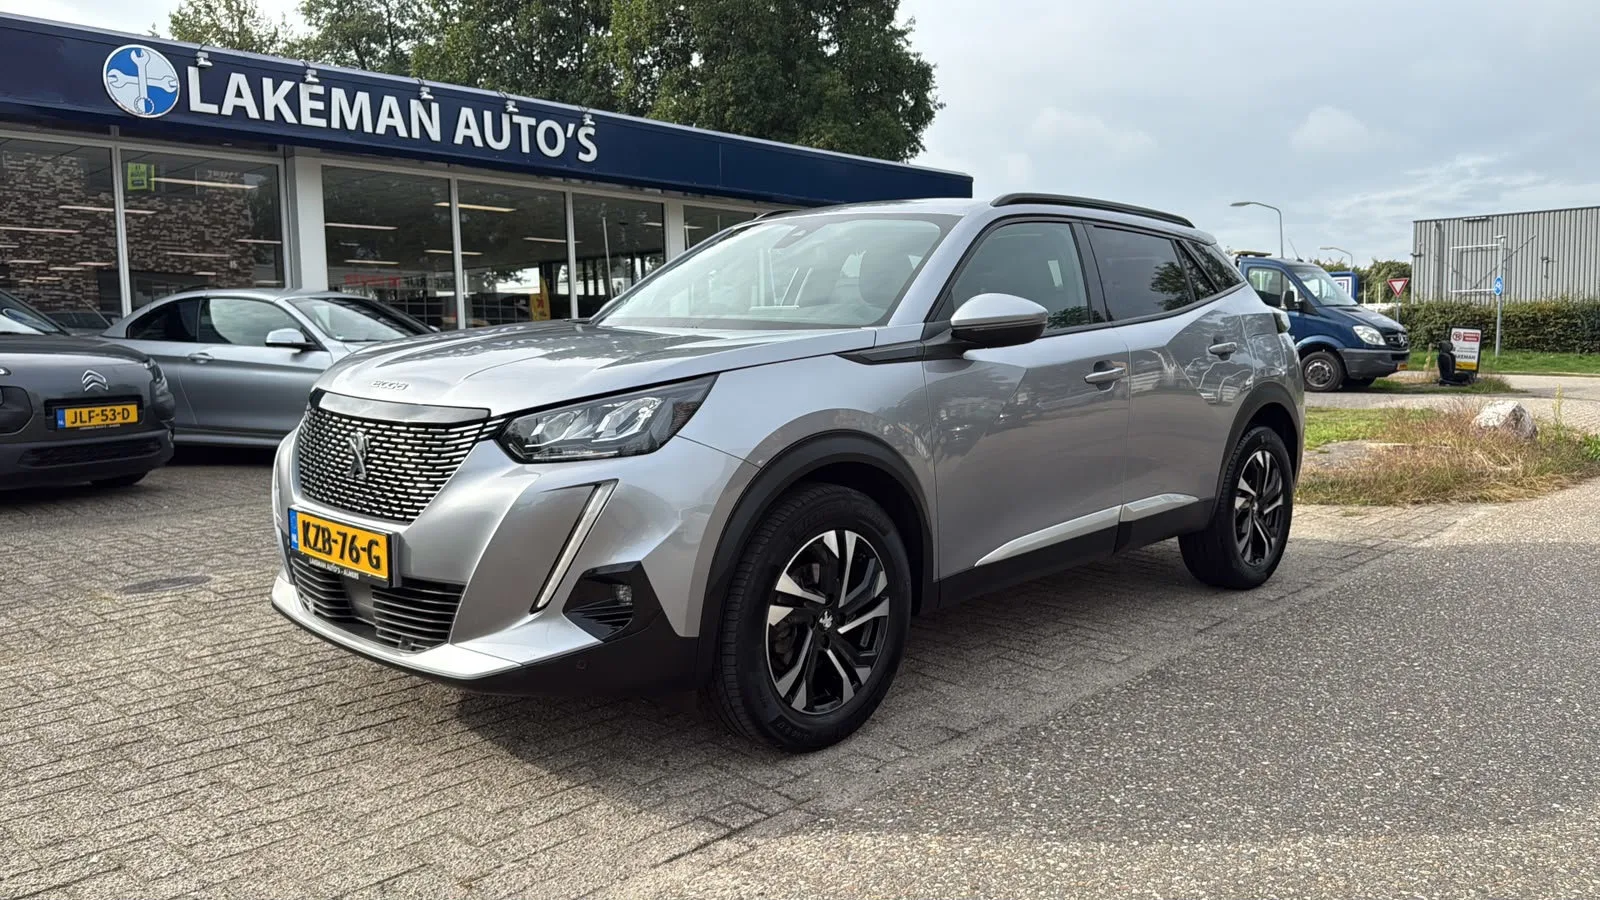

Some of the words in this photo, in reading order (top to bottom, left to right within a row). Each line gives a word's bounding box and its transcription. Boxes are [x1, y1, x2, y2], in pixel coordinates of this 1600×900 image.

[187, 66, 442, 142] LAKEMAN
[453, 107, 599, 163] AUTO'S
[70, 408, 130, 425] JLF-53-D
[302, 519, 382, 571] KZB-76-G
